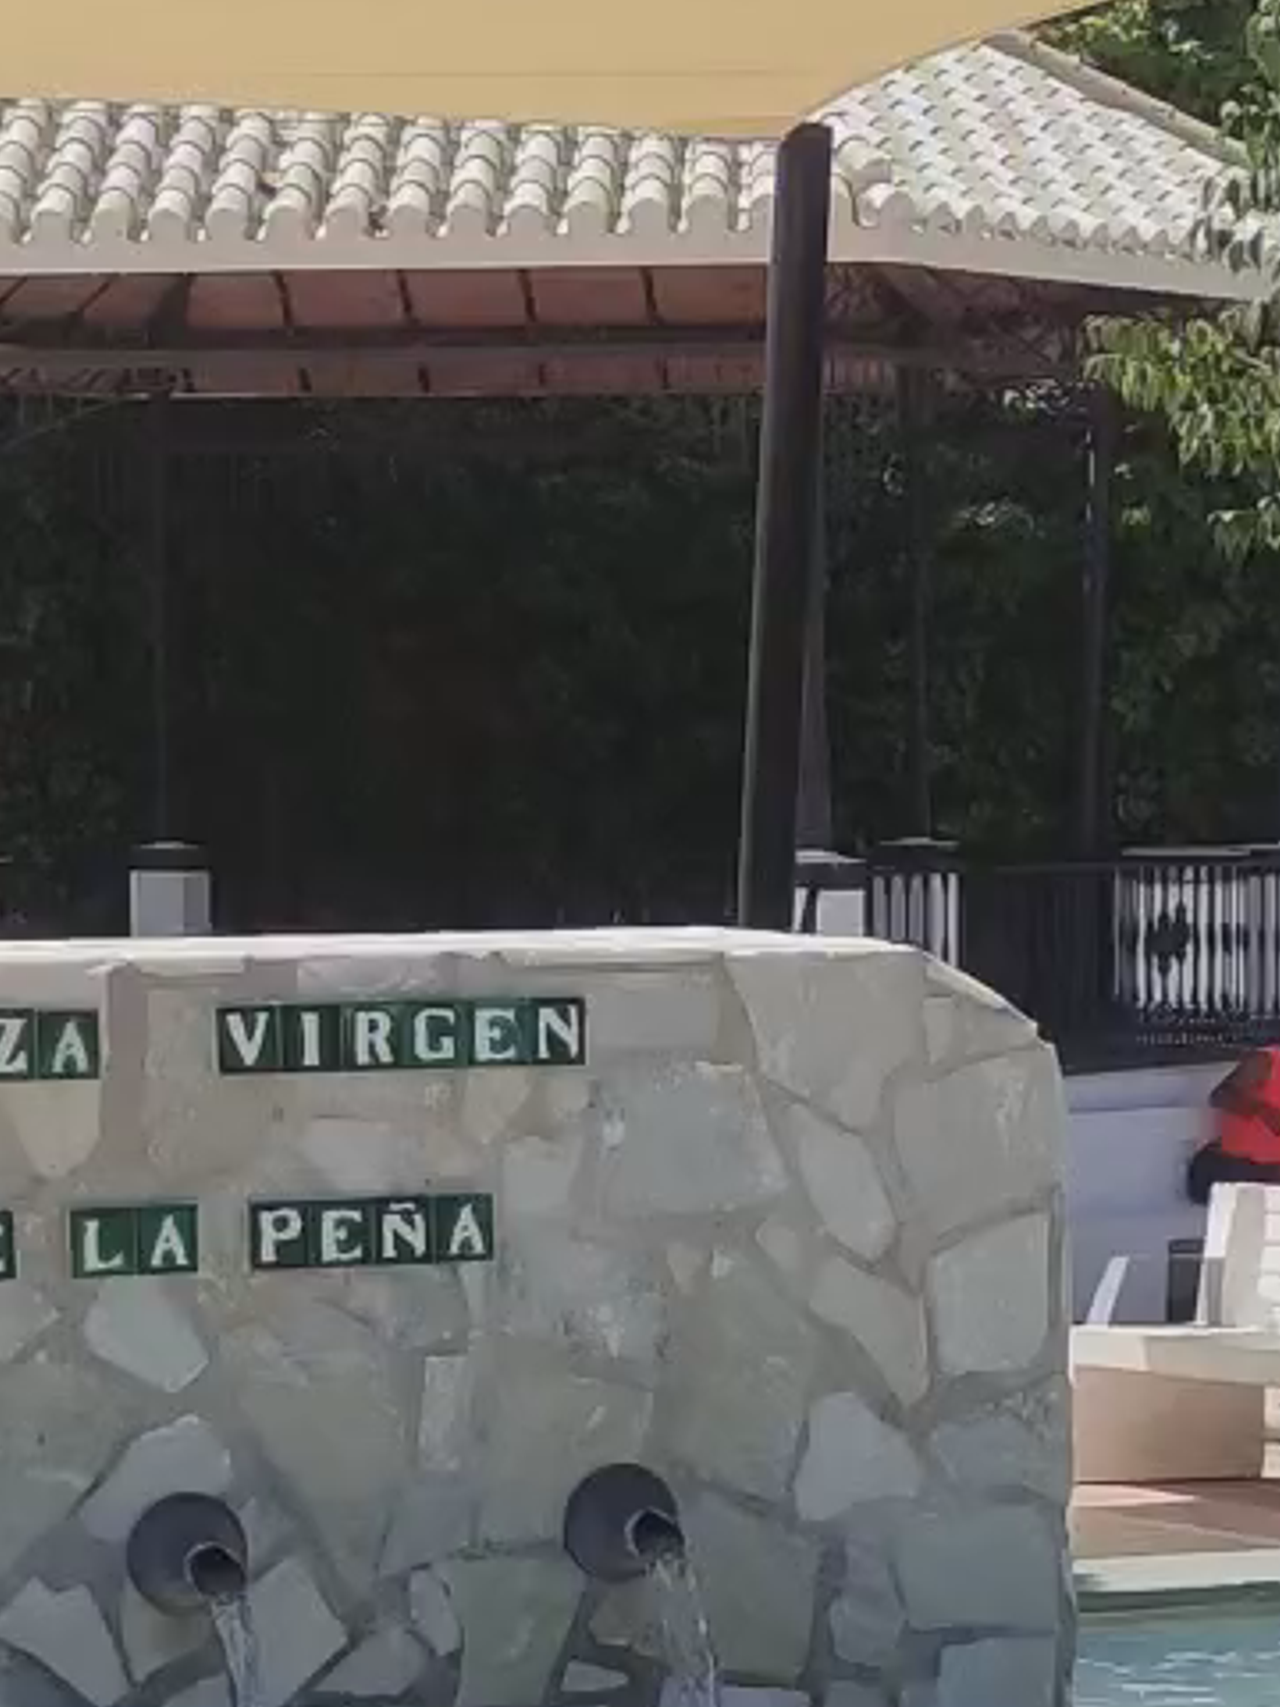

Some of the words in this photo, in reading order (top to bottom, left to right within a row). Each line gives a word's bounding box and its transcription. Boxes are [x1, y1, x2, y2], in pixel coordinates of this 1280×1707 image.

[225, 1004, 580, 1067] VIRGEN
[82, 1213, 190, 1273] LA
[257, 1201, 487, 1264] PEÑA
